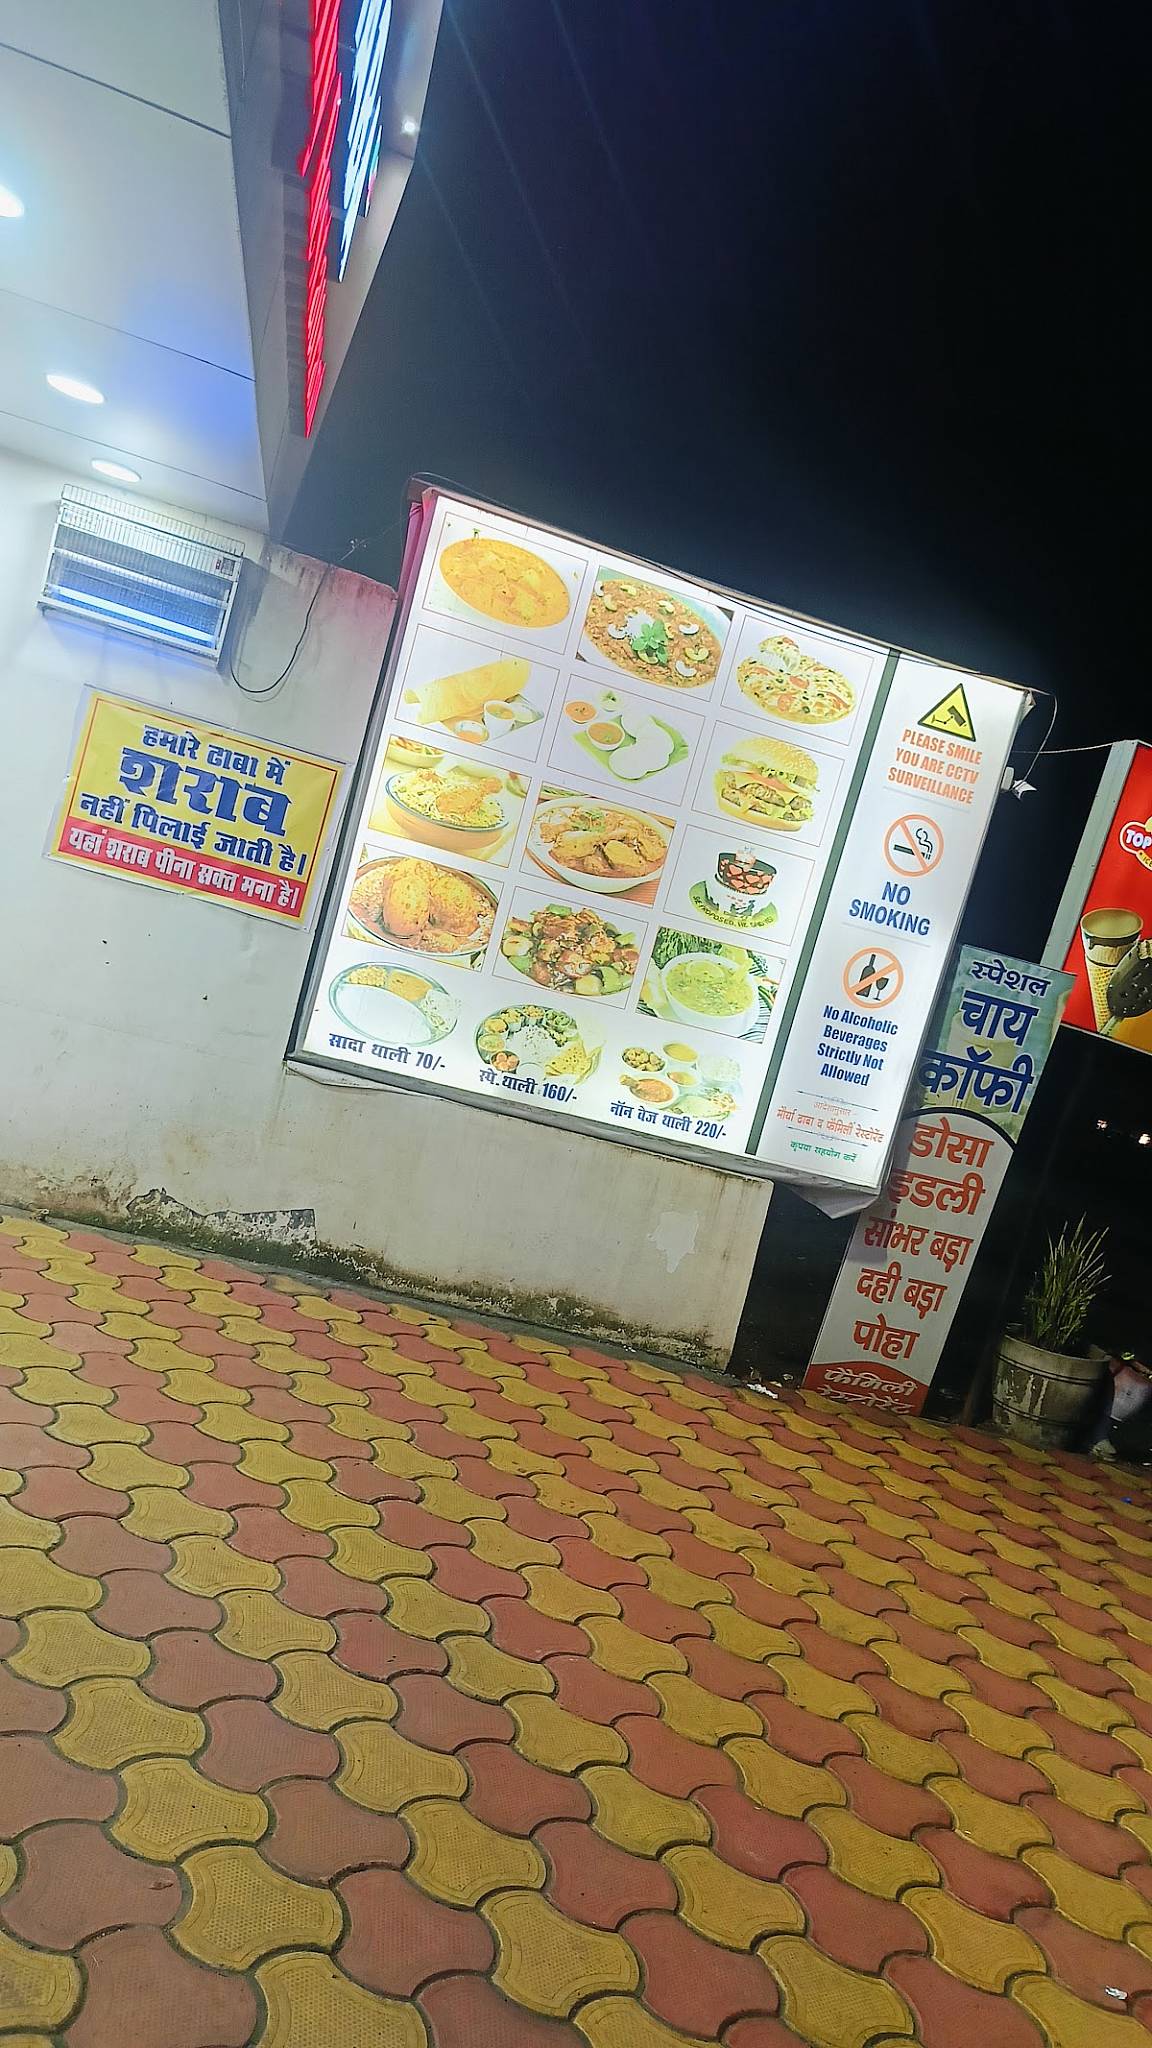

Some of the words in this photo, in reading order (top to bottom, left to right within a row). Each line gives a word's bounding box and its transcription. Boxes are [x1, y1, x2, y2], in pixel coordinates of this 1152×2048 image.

[142, 725, 201, 759] हमारे
[265, 757, 291, 785] में
[902, 729, 945, 754] PLEASE
[946, 742, 983, 765] SMILE
[895, 748, 921, 766] YOU
[920, 757, 945, 775] ARE
[945, 763, 979, 785] CCTV
[119, 747, 293, 836] शराब
[887, 767, 974, 805] SURVEILLANCE
[80, 793, 130, 823] नहीं
[131, 803, 211, 849] पिलाई
[214, 831, 275, 866] जाती
[68, 827, 107, 855] यहां
[106, 838, 153, 868] शराब
[154, 848, 196, 880] पीना
[240, 875, 276, 903] मना
[881, 881, 911, 906] NO
[849, 899, 930, 936] SMOKING
[971, 959, 1050, 997] स्पेशल
[823, 1005, 839, 1021] No
[840, 1009, 899, 1036] Alcoholic
[960, 989, 1040, 1047] चाय
[328, 1033, 366, 1053] सादा
[371, 1043, 411, 1064] थाली
[416, 1051, 445, 1071] 70/-
[817, 1043, 863, 1066] Strictly
[863, 1055, 884, 1071] Not
[823, 1025, 888, 1053] Beverages
[543, 1083, 577, 1102] 160/-
[820, 1063, 870, 1087] Allowed
[918, 1046, 1034, 1114] कॉफी
[610, 1100, 635, 1119] नॉन
[637, 1105, 659, 1124] वेज
[662, 1114, 692, 1132] थाली
[694, 1120, 727, 1139] 220/-
[908, 1116, 995, 1168] डोसा
[887, 1168, 986, 1215] इडली
[863, 1208, 929, 1255] सांभर
[930, 1230, 975, 1273] बड़ा
[856, 1261, 902, 1303] दही
[903, 1278, 948, 1321] बड़ा
[853, 1313, 920, 1360] पोहा
